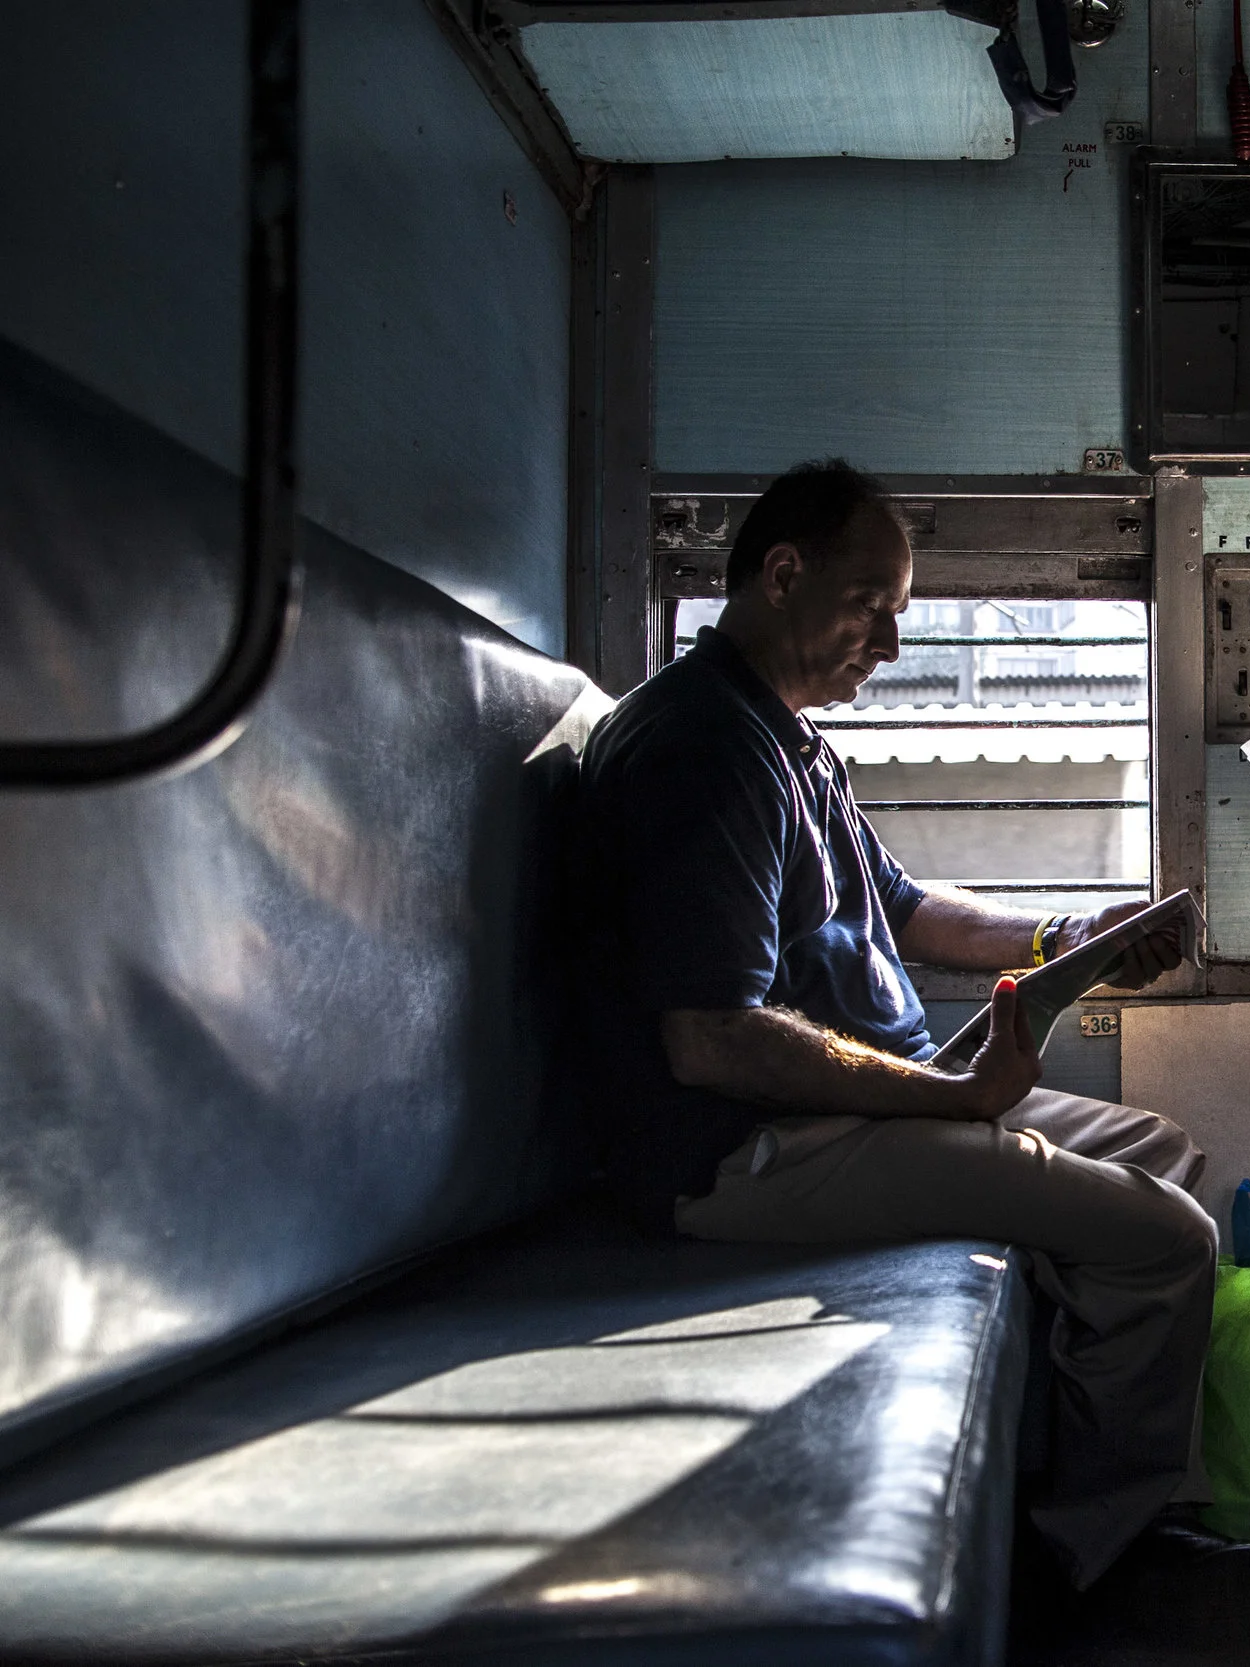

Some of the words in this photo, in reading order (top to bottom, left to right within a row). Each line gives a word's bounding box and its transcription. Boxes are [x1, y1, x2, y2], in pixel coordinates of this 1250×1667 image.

[1115, 125, 1136, 141] 38
[1062, 143, 1097, 153] ALARM
[1068, 158, 1091, 168] PULL
[1096, 452, 1116, 468] 37
[1219, 535, 1227, 548] F
[1090, 1016, 1112, 1033] 36
